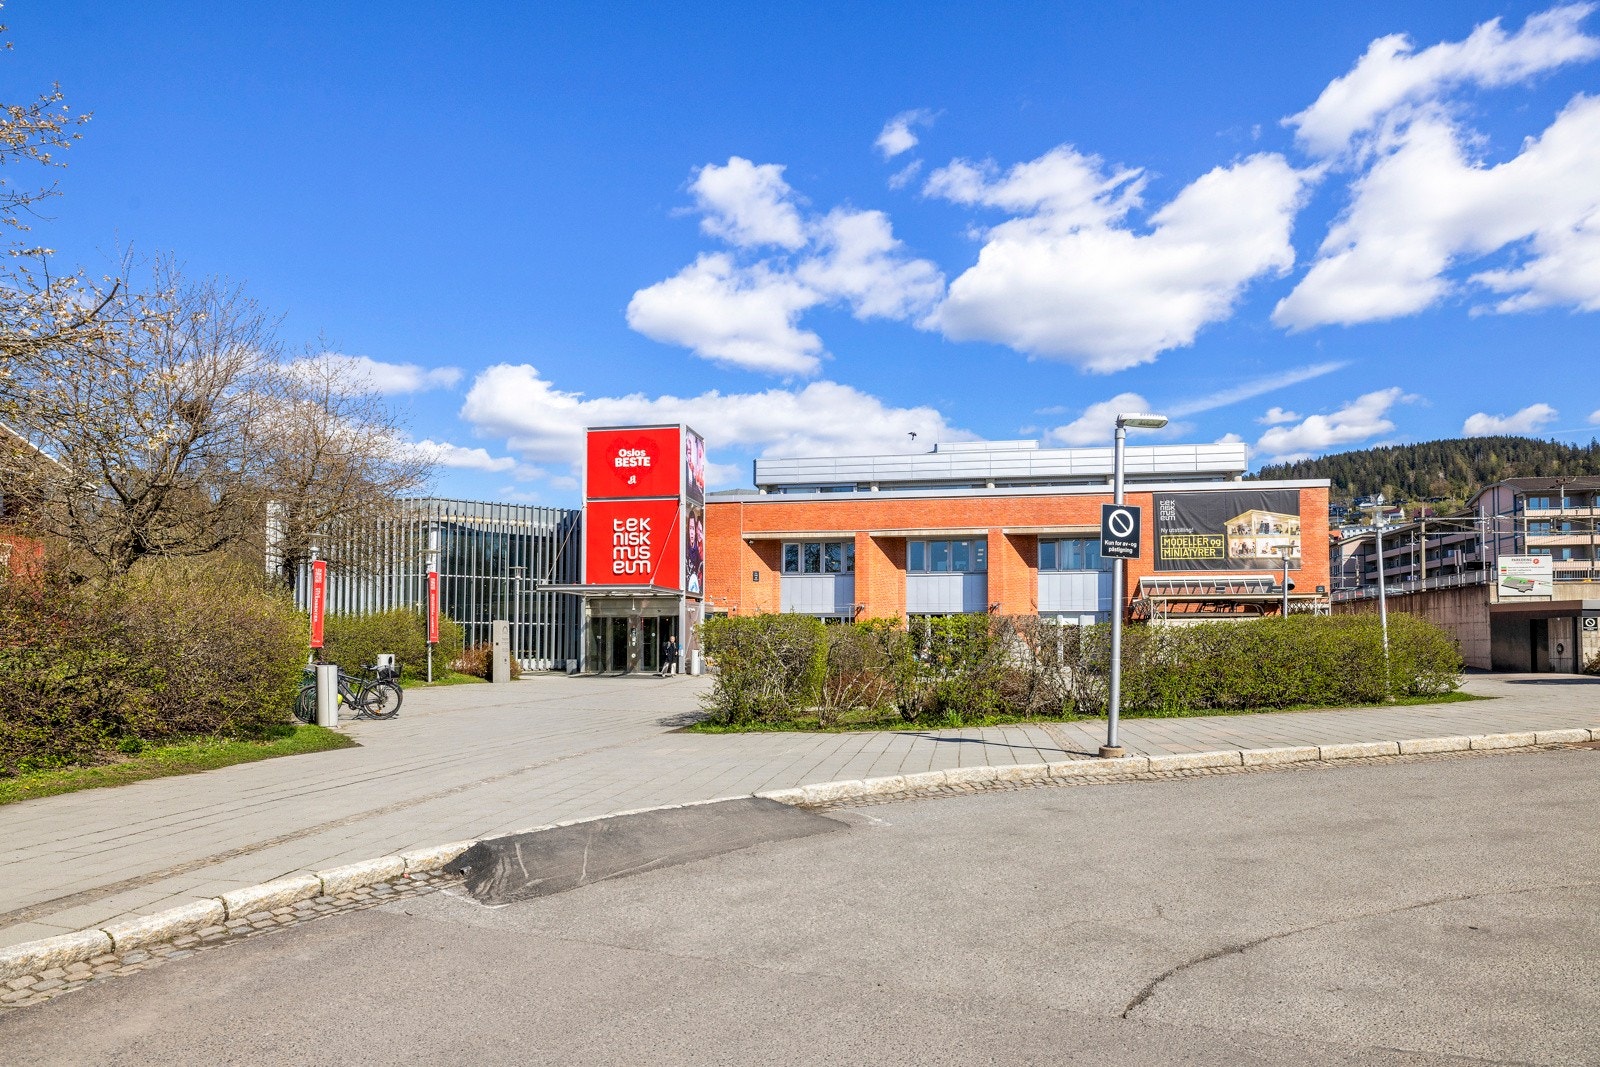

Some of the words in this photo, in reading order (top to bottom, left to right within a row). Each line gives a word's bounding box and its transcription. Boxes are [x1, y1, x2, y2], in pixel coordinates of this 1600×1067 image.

[618, 448, 646, 457] Oslos
[614, 456, 651, 467] BESTE
[613, 517, 651, 532] tek
[1163, 537, 1209, 547] MODELLER
[1210, 538, 1221, 547] og
[613, 545, 651, 560] mus
[1163, 547, 1216, 557] MINIATYRER
[613, 559, 651, 574] eum
